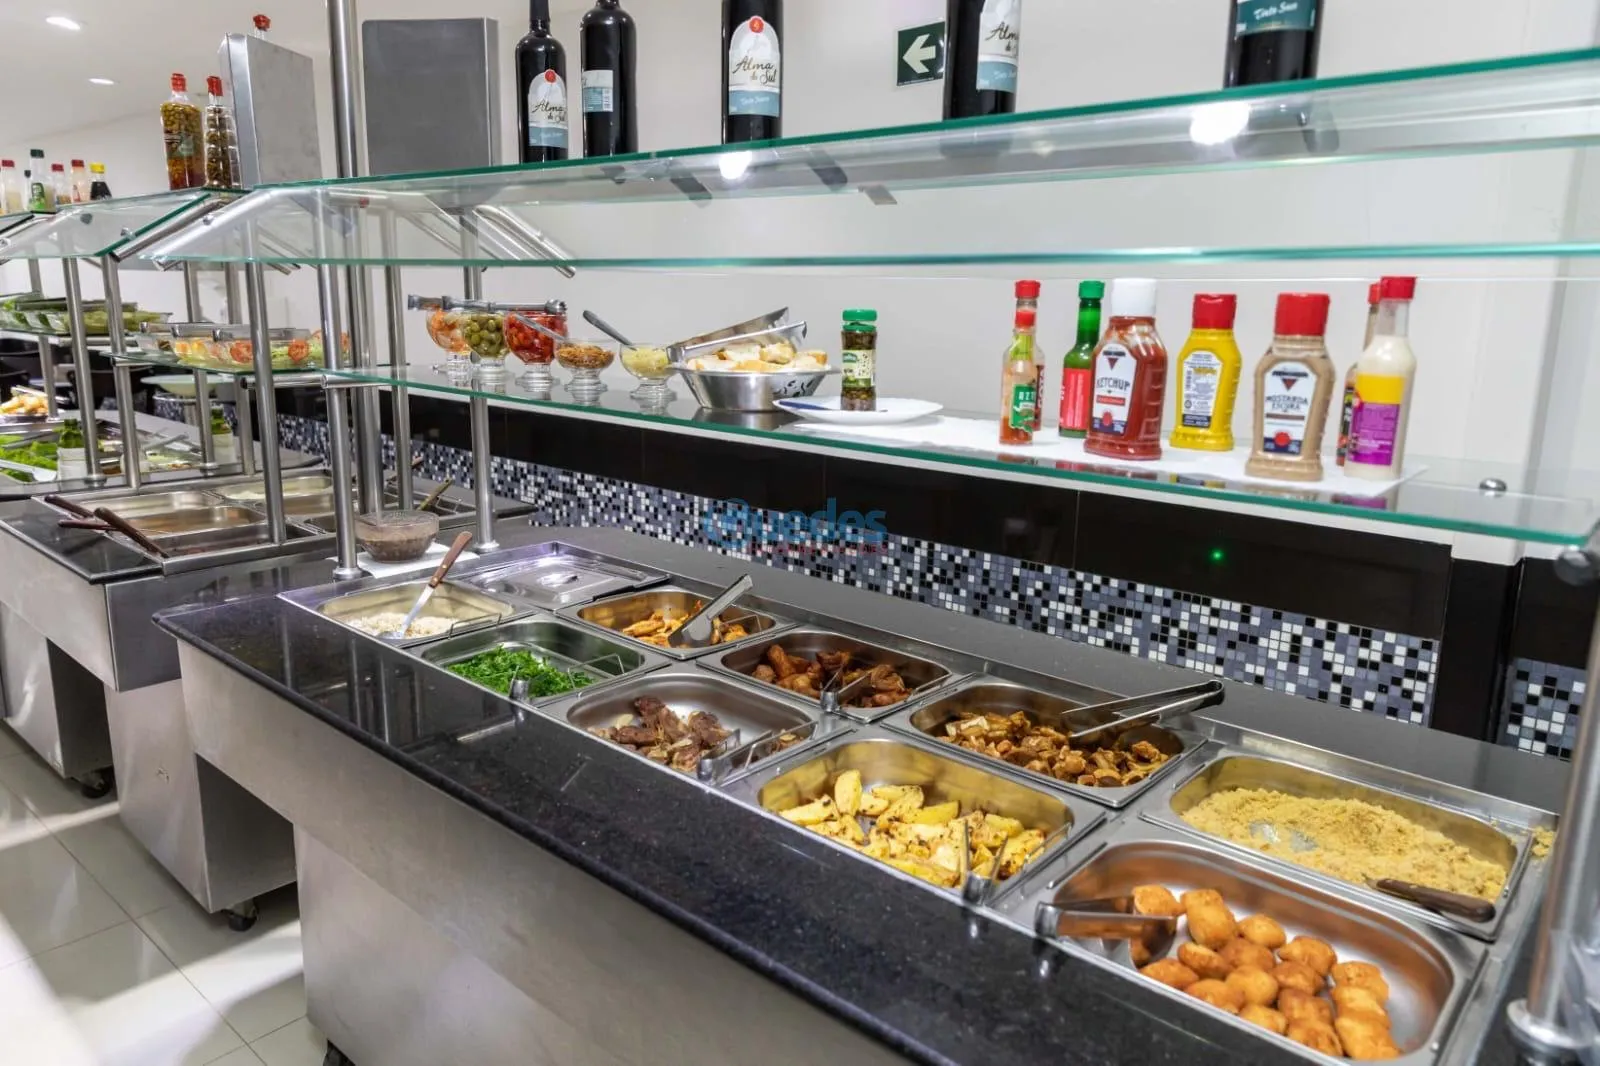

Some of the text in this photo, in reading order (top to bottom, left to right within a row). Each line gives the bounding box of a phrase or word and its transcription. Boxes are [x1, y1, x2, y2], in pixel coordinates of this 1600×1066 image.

[733, 56, 773, 74] Alma
[759, 69, 777, 85] Sul
[532, 98, 564, 113] Alma
[1096, 377, 1130, 391] KETCHUP
[1265, 394, 1308, 405] MOSTARDA
